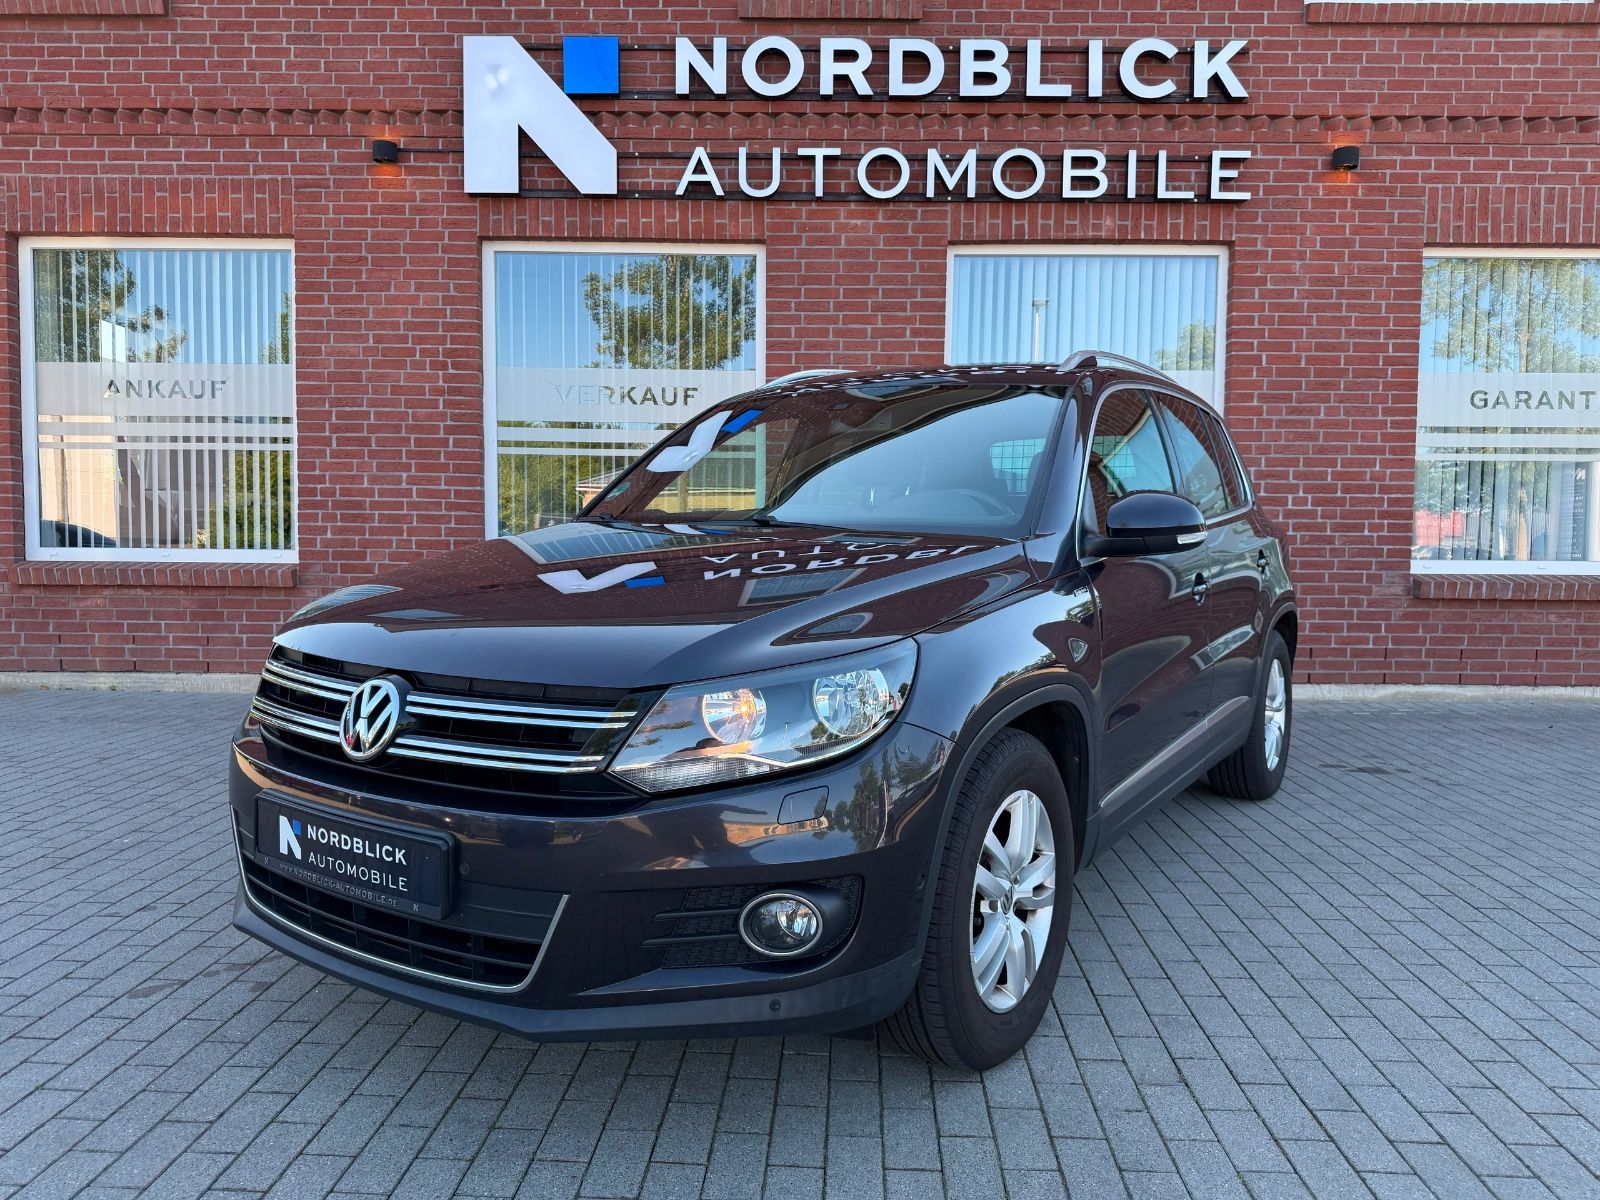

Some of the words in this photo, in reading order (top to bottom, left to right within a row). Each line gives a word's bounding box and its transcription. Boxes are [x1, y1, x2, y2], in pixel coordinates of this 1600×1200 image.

[675, 36, 1249, 98] NORDBLICK
[675, 146, 1252, 200] AUTOMOBILE
[104, 379, 227, 400] ANKAUF
[554, 383, 699, 406] VERKAUF
[1469, 389, 1597, 410] GARANT
[307, 823, 408, 866] NORDBLICK
[308, 851, 408, 892] AUTOMOBILE
